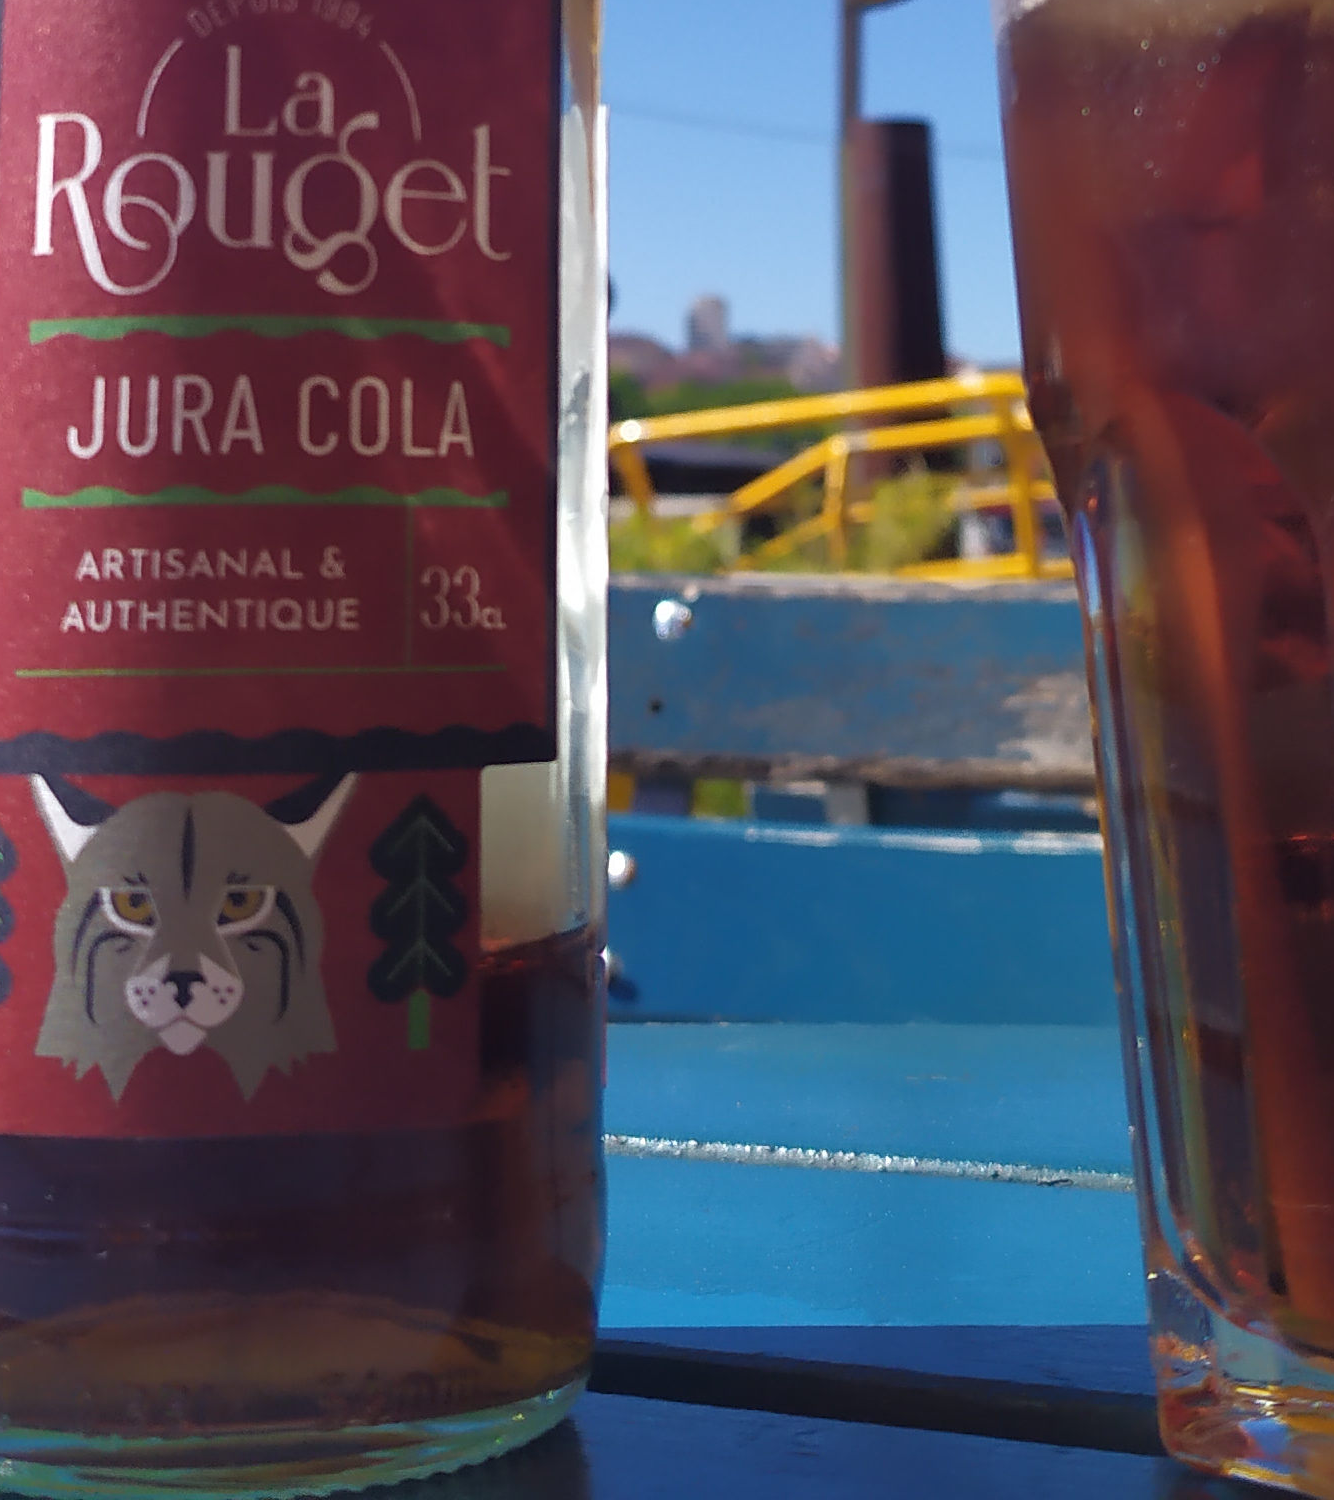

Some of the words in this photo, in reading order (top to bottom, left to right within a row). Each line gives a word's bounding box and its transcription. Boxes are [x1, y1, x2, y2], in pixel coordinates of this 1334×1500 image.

[223, 44, 336, 137] La
[31, 110, 511, 295] Rouget
[67, 374, 264, 459] JURA
[298, 375, 474, 458] COLA
[75, 547, 305, 583] ARTISANAL
[319, 545, 347, 582] &
[59, 599, 362, 634] AUTHENTIQUE
